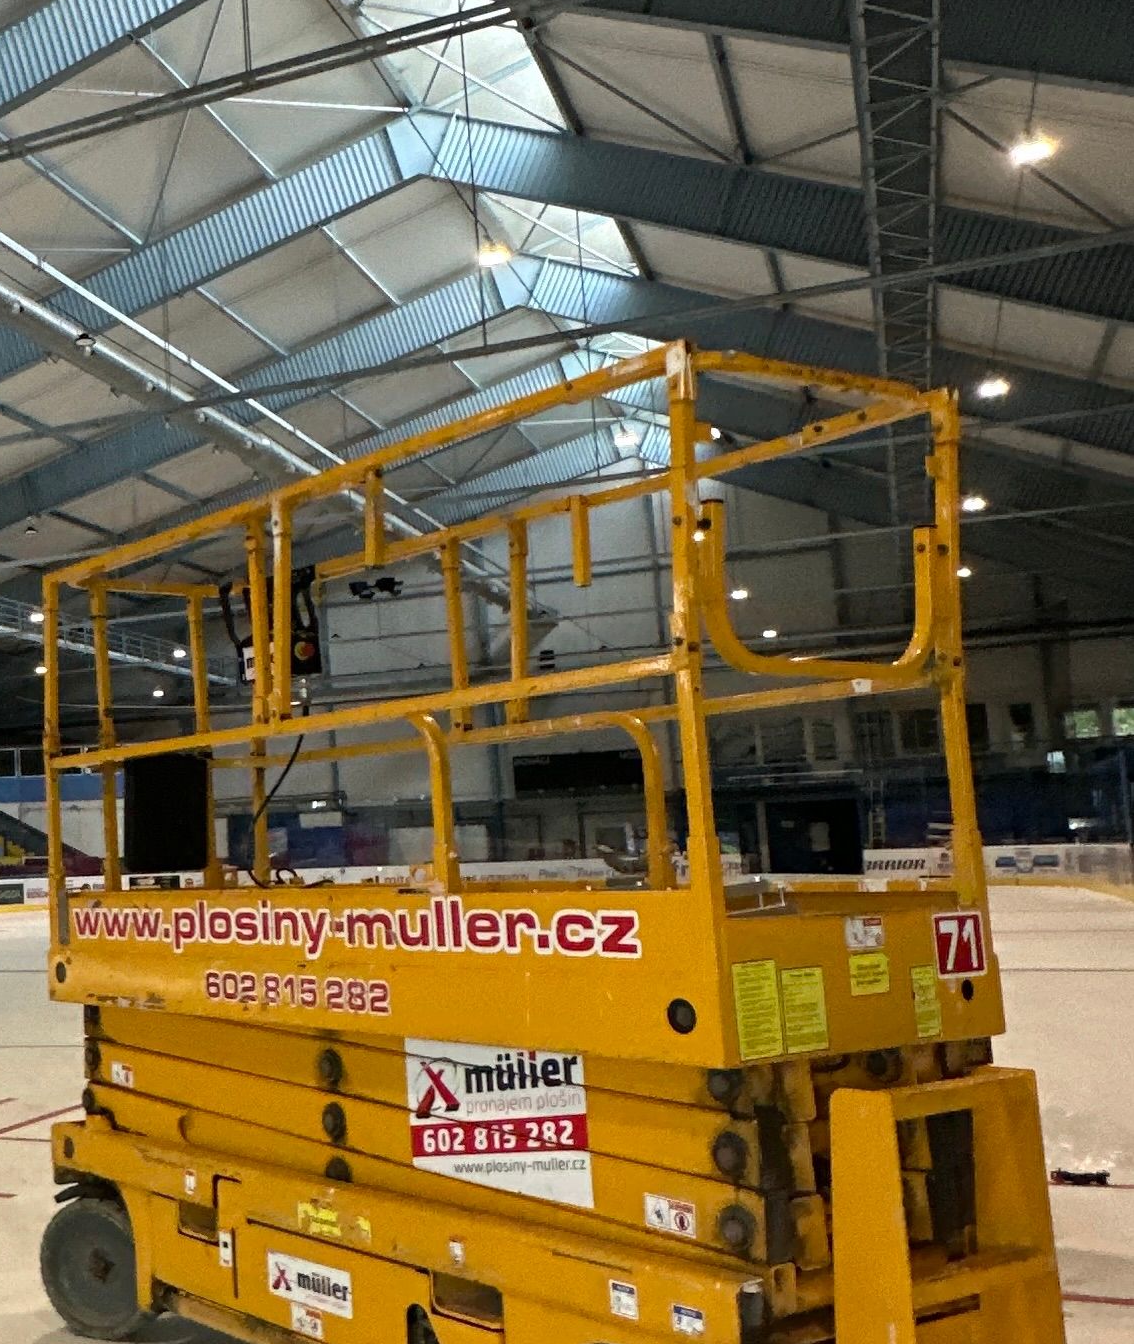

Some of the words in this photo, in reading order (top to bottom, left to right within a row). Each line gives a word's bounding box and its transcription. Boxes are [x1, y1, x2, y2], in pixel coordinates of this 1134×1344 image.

[72, 897, 641, 957] www.plosiny-muller.cz
[938, 919, 978, 970] 71
[205, 970, 259, 1003] 602
[263, 974, 316, 1008] 815
[325, 978, 390, 1015] 282
[466, 1051, 578, 1094] müller
[422, 1127, 466, 1153] 602
[474, 1123, 517, 1150] 815
[525, 1119, 575, 1148] 282
[454, 1157, 586, 1174] www.plosiny-muller.cz
[297, 1271, 350, 1302] müller
